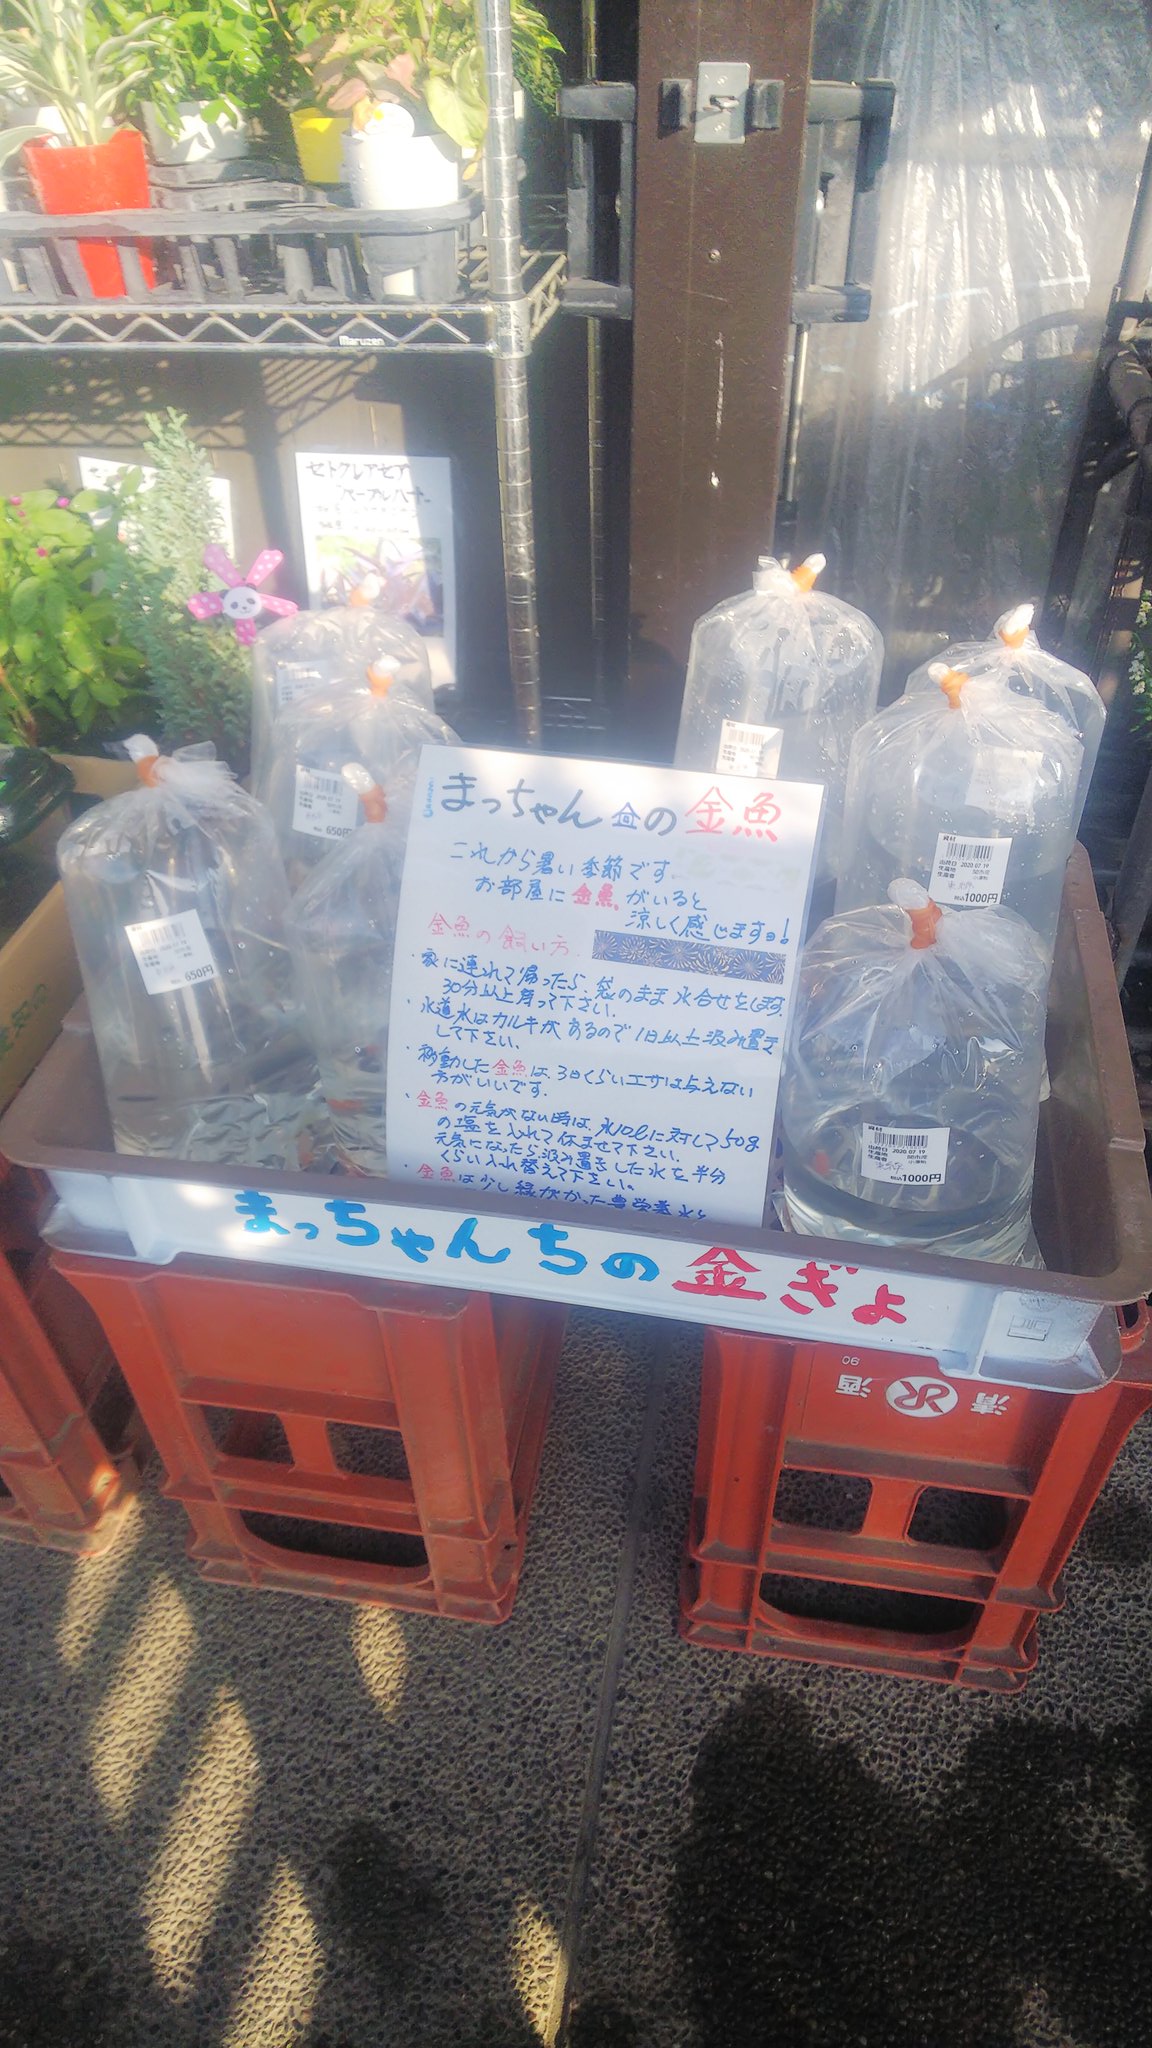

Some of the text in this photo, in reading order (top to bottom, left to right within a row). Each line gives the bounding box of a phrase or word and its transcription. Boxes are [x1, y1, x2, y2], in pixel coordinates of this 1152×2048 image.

[339, 335, 385, 346] Maruzen
[441, 772, 601, 829] まっちゃん
[965, 893, 998, 903] 1000円
[184, 964, 214, 982] 650円
[902, 1173, 942, 1183] 1000円
